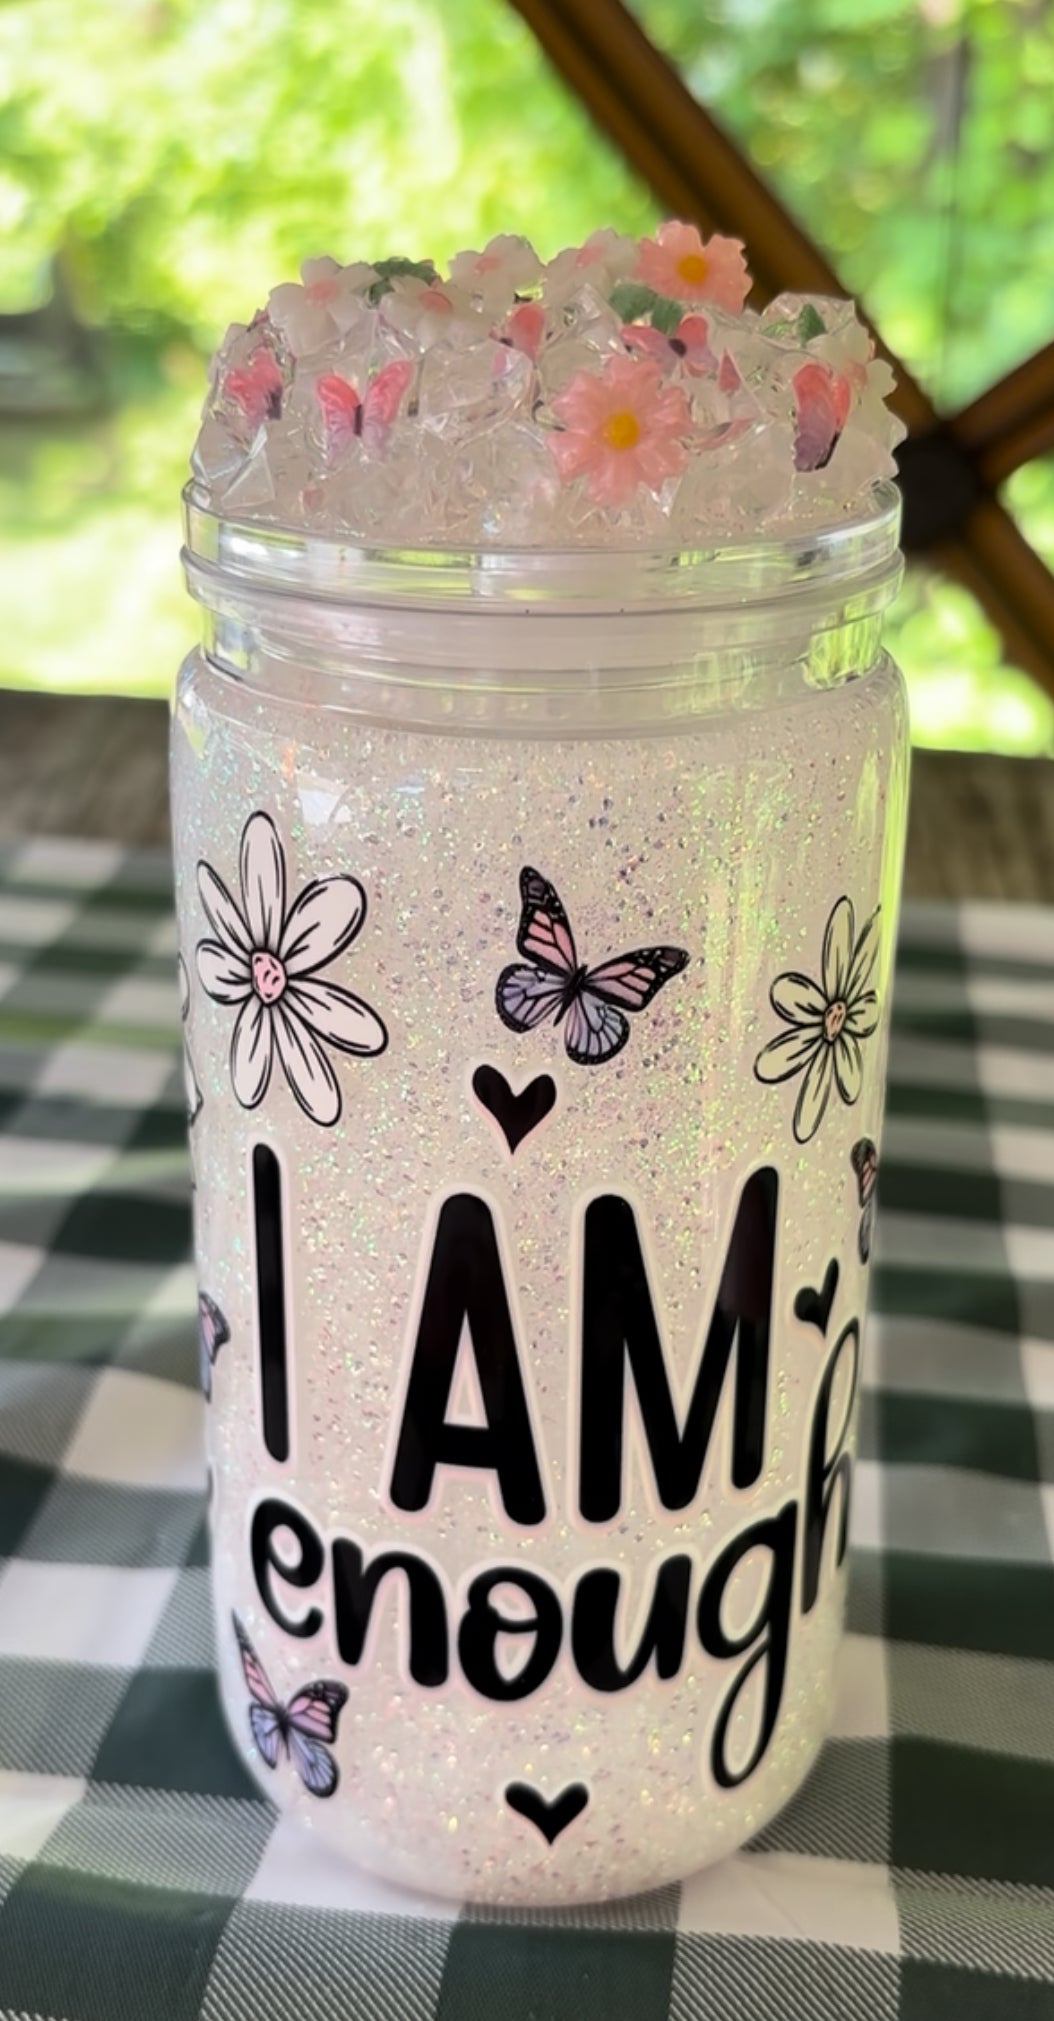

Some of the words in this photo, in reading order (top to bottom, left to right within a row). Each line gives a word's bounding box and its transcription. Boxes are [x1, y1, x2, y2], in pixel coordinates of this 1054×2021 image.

[252, 1143, 289, 1463] I
[390, 1166, 779, 1526] AM
[250, 1317, 860, 1790] enough
